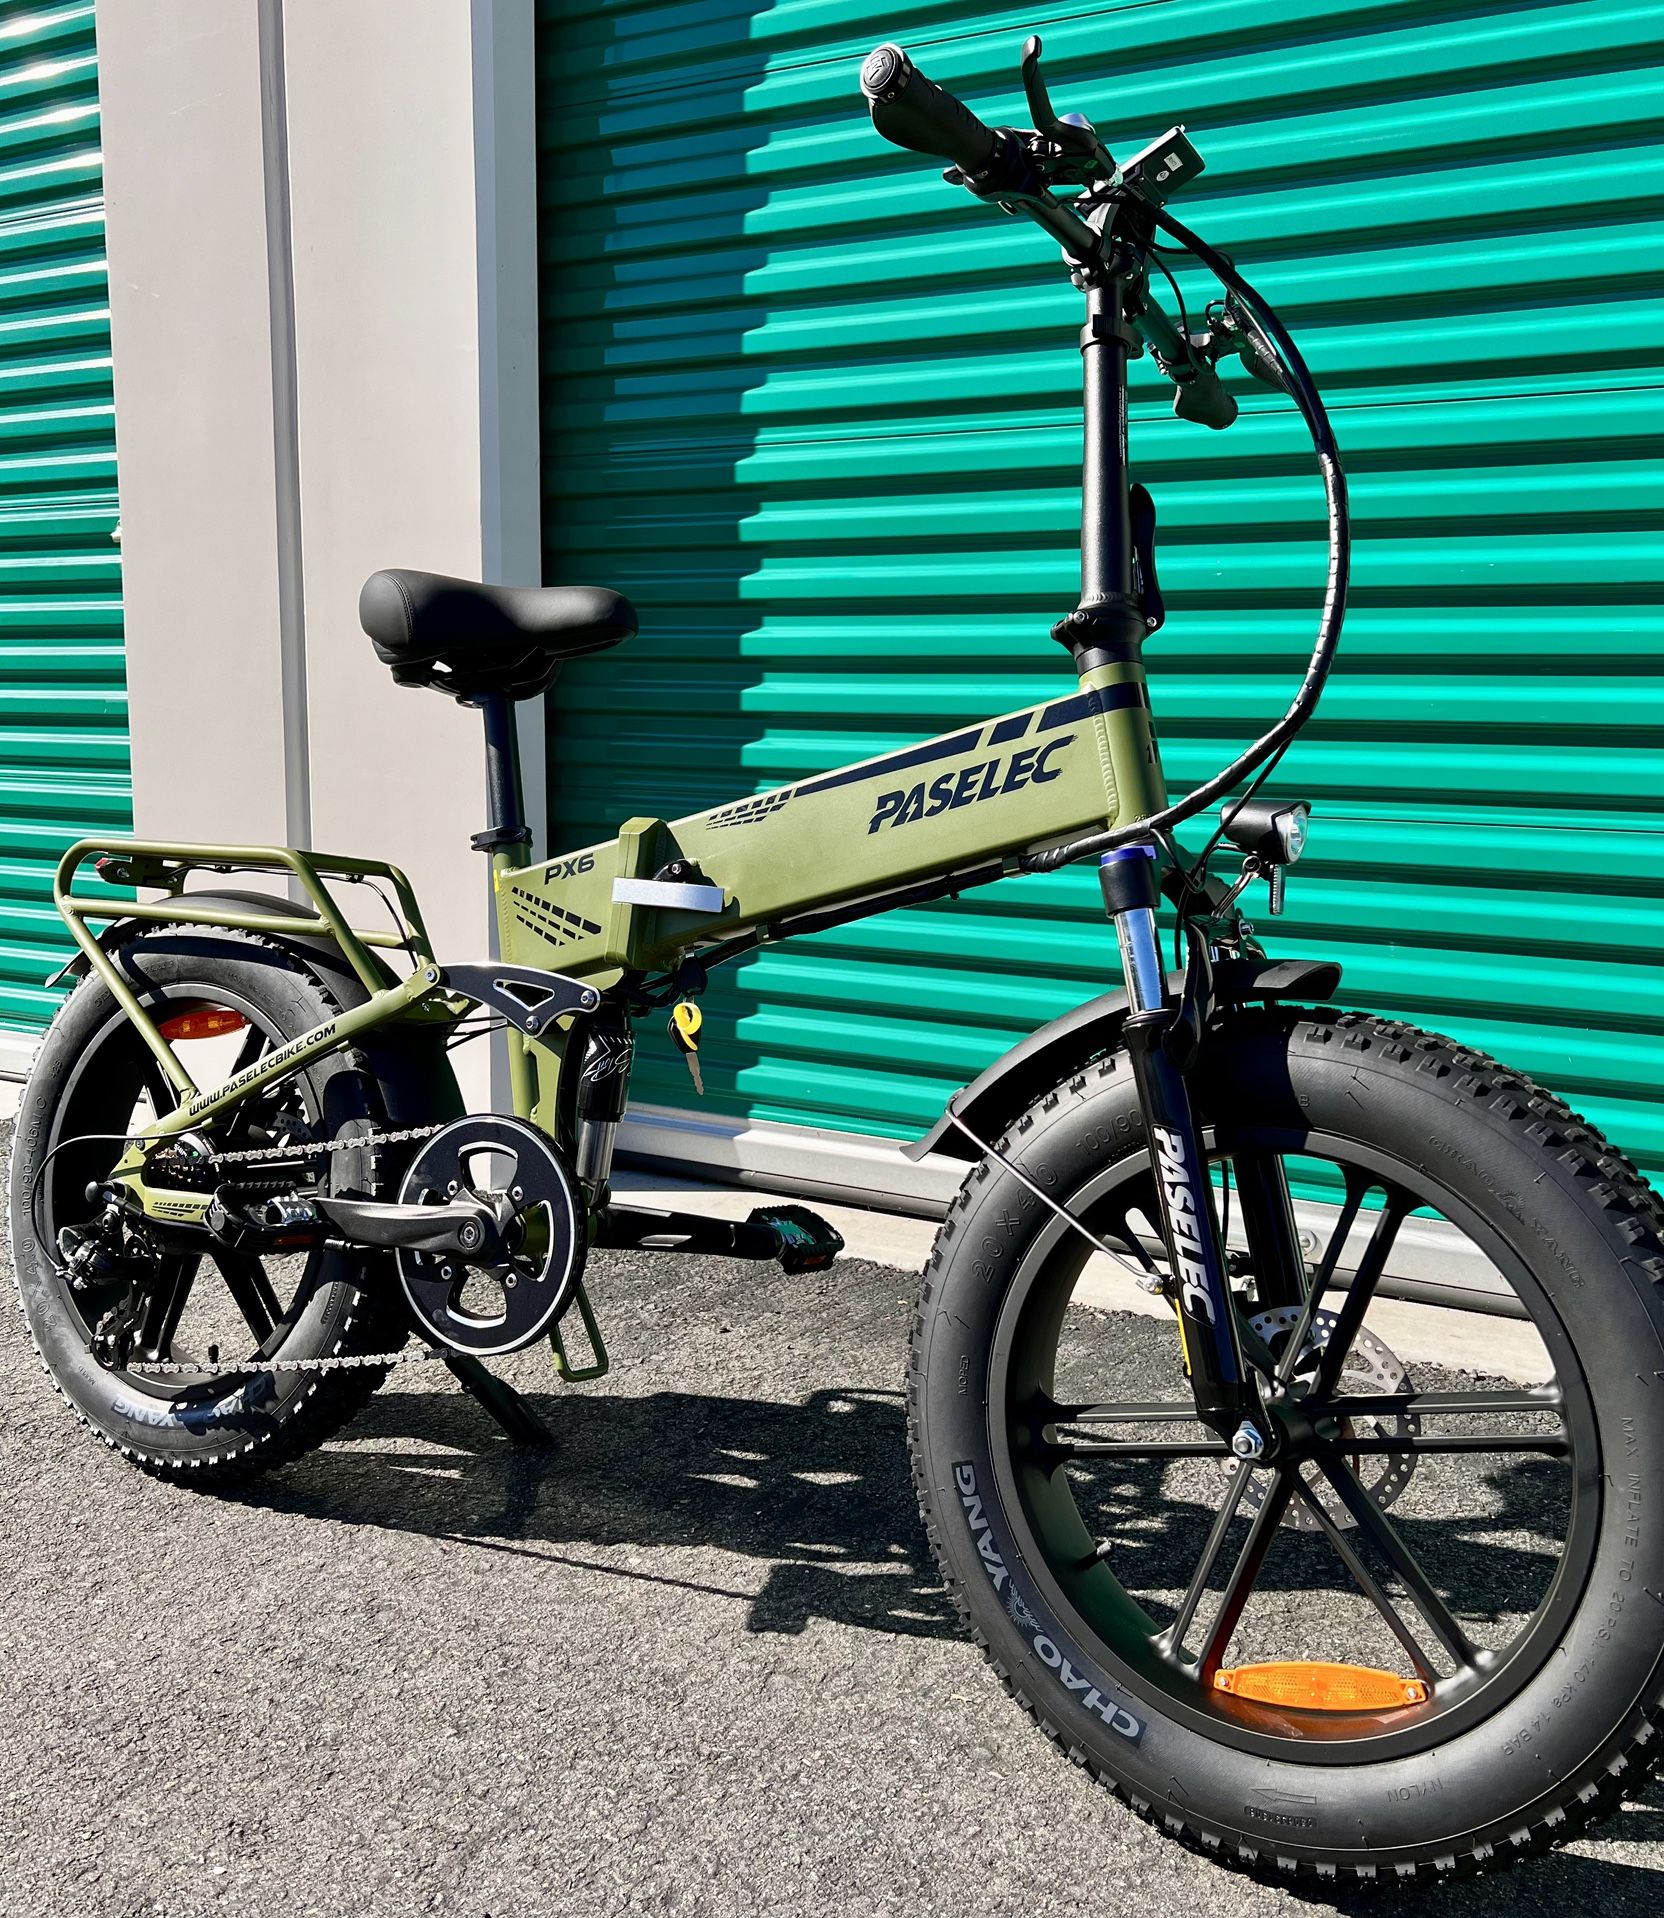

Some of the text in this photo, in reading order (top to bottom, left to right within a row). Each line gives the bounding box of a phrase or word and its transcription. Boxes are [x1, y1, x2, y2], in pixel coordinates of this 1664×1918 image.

[868, 733, 1080, 835] PASELEC
[544, 853, 596, 886] PX6
[189, 1023, 337, 1117] WWW.PASELECBIKE.COM
[1153, 1126, 1217, 1326] PASELEC
[971, 1236, 1005, 1284] 20
[112, 1399, 176, 1428] YANG
[1625, 1473, 1641, 1549] INFLATE
[1619, 1559, 1635, 1583] TO
[955, 1464, 1140, 1739] CHAO YANG
[1500, 1728, 1533, 1757] BAR
[1386, 1778, 1444, 1803] NYLON
